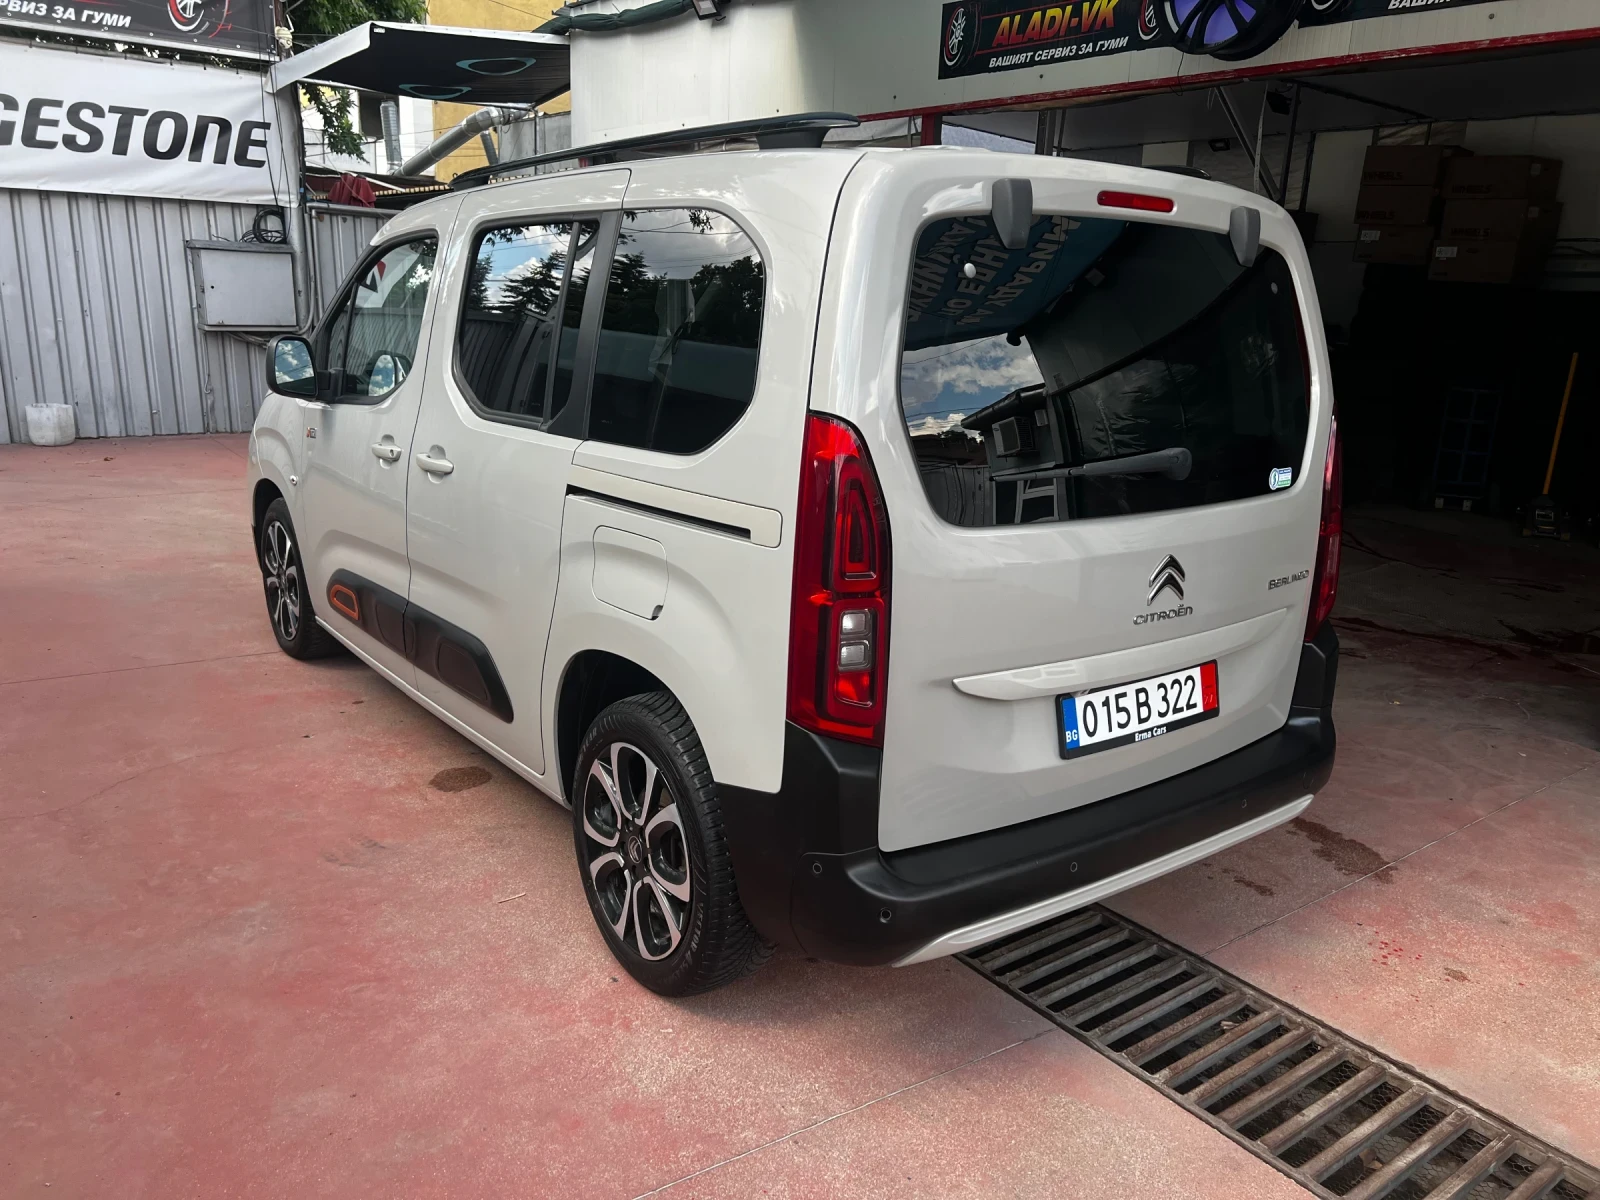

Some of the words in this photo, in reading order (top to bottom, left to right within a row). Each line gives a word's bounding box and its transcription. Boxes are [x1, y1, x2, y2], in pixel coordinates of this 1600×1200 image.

[52, 5, 76, 21] ЗА
[81, 9, 132, 28] ГУМИ
[991, 0, 1119, 47] ALADI-VK
[989, 51, 1034, 68] ВАШИЯТ
[1034, 45, 1076, 62] СЕРВИЗ
[1078, 43, 1094, 56] ЗА
[1095, 36, 1129, 52] ГУМИ
[1065, 729, 1079, 743] BG
[1134, 732, 1152, 742] Erma
[1152, 725, 1167, 736] Cars
